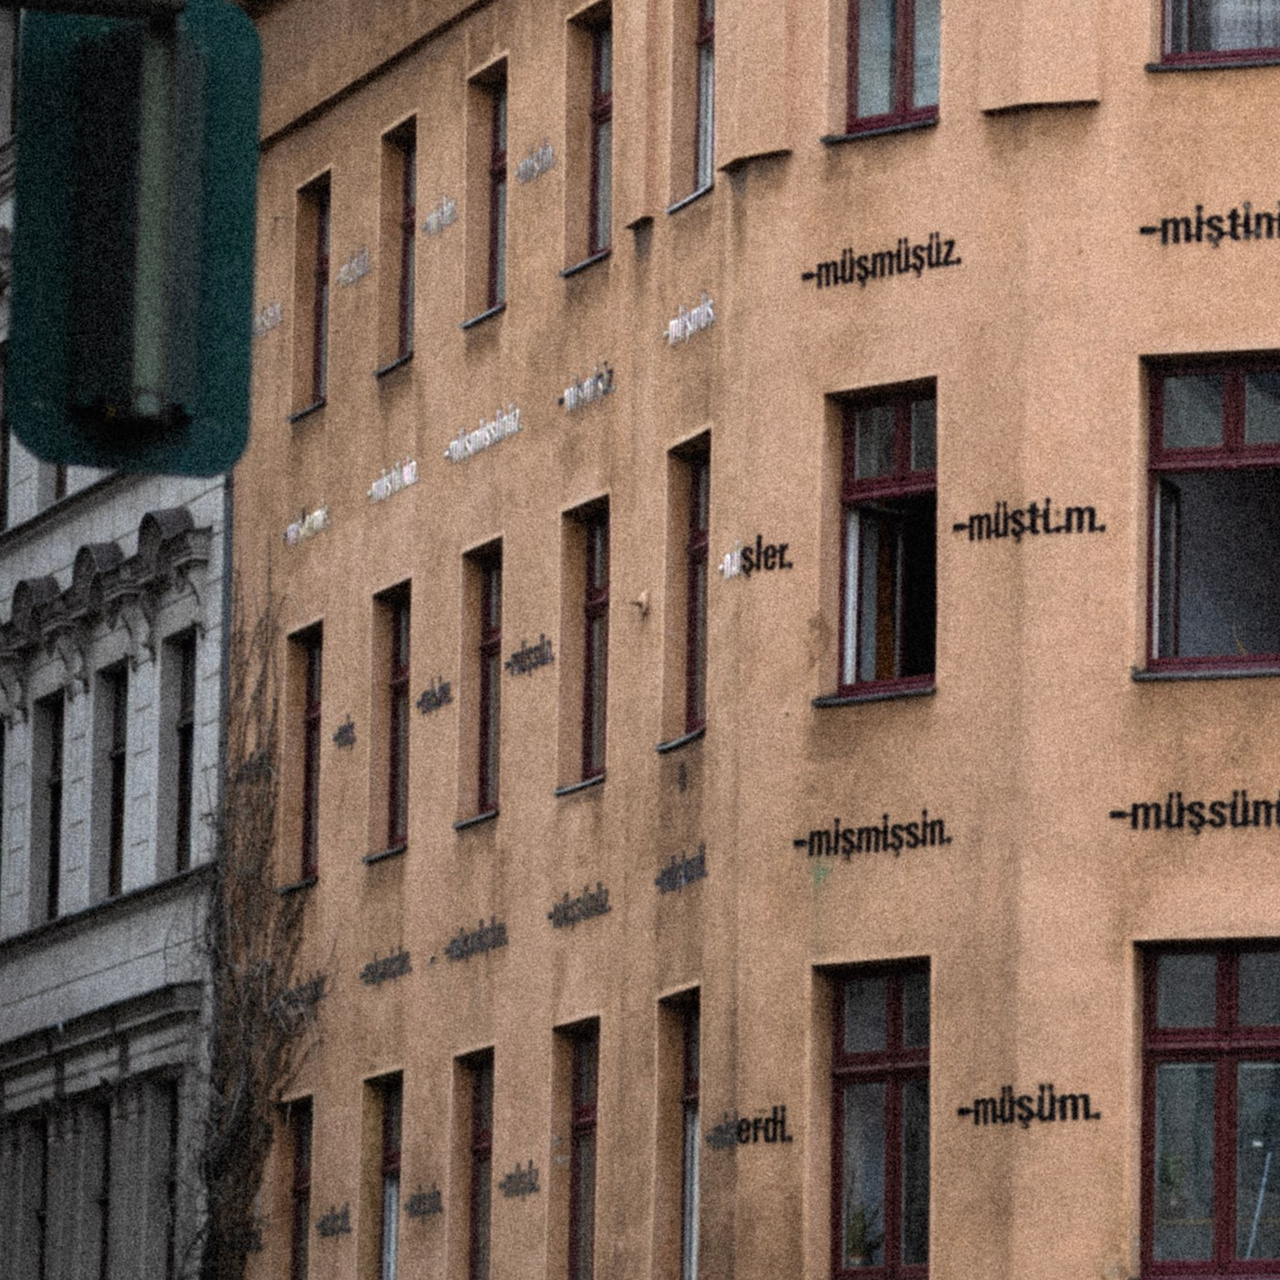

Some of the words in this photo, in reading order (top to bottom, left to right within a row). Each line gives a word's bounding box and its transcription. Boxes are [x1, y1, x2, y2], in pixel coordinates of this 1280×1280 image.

[802, 232, 962, 290] -müşmüşüz.
[793, 809, 953, 861] -mişmişsin.
[956, 1084, 1101, 1128] -müşüm.
